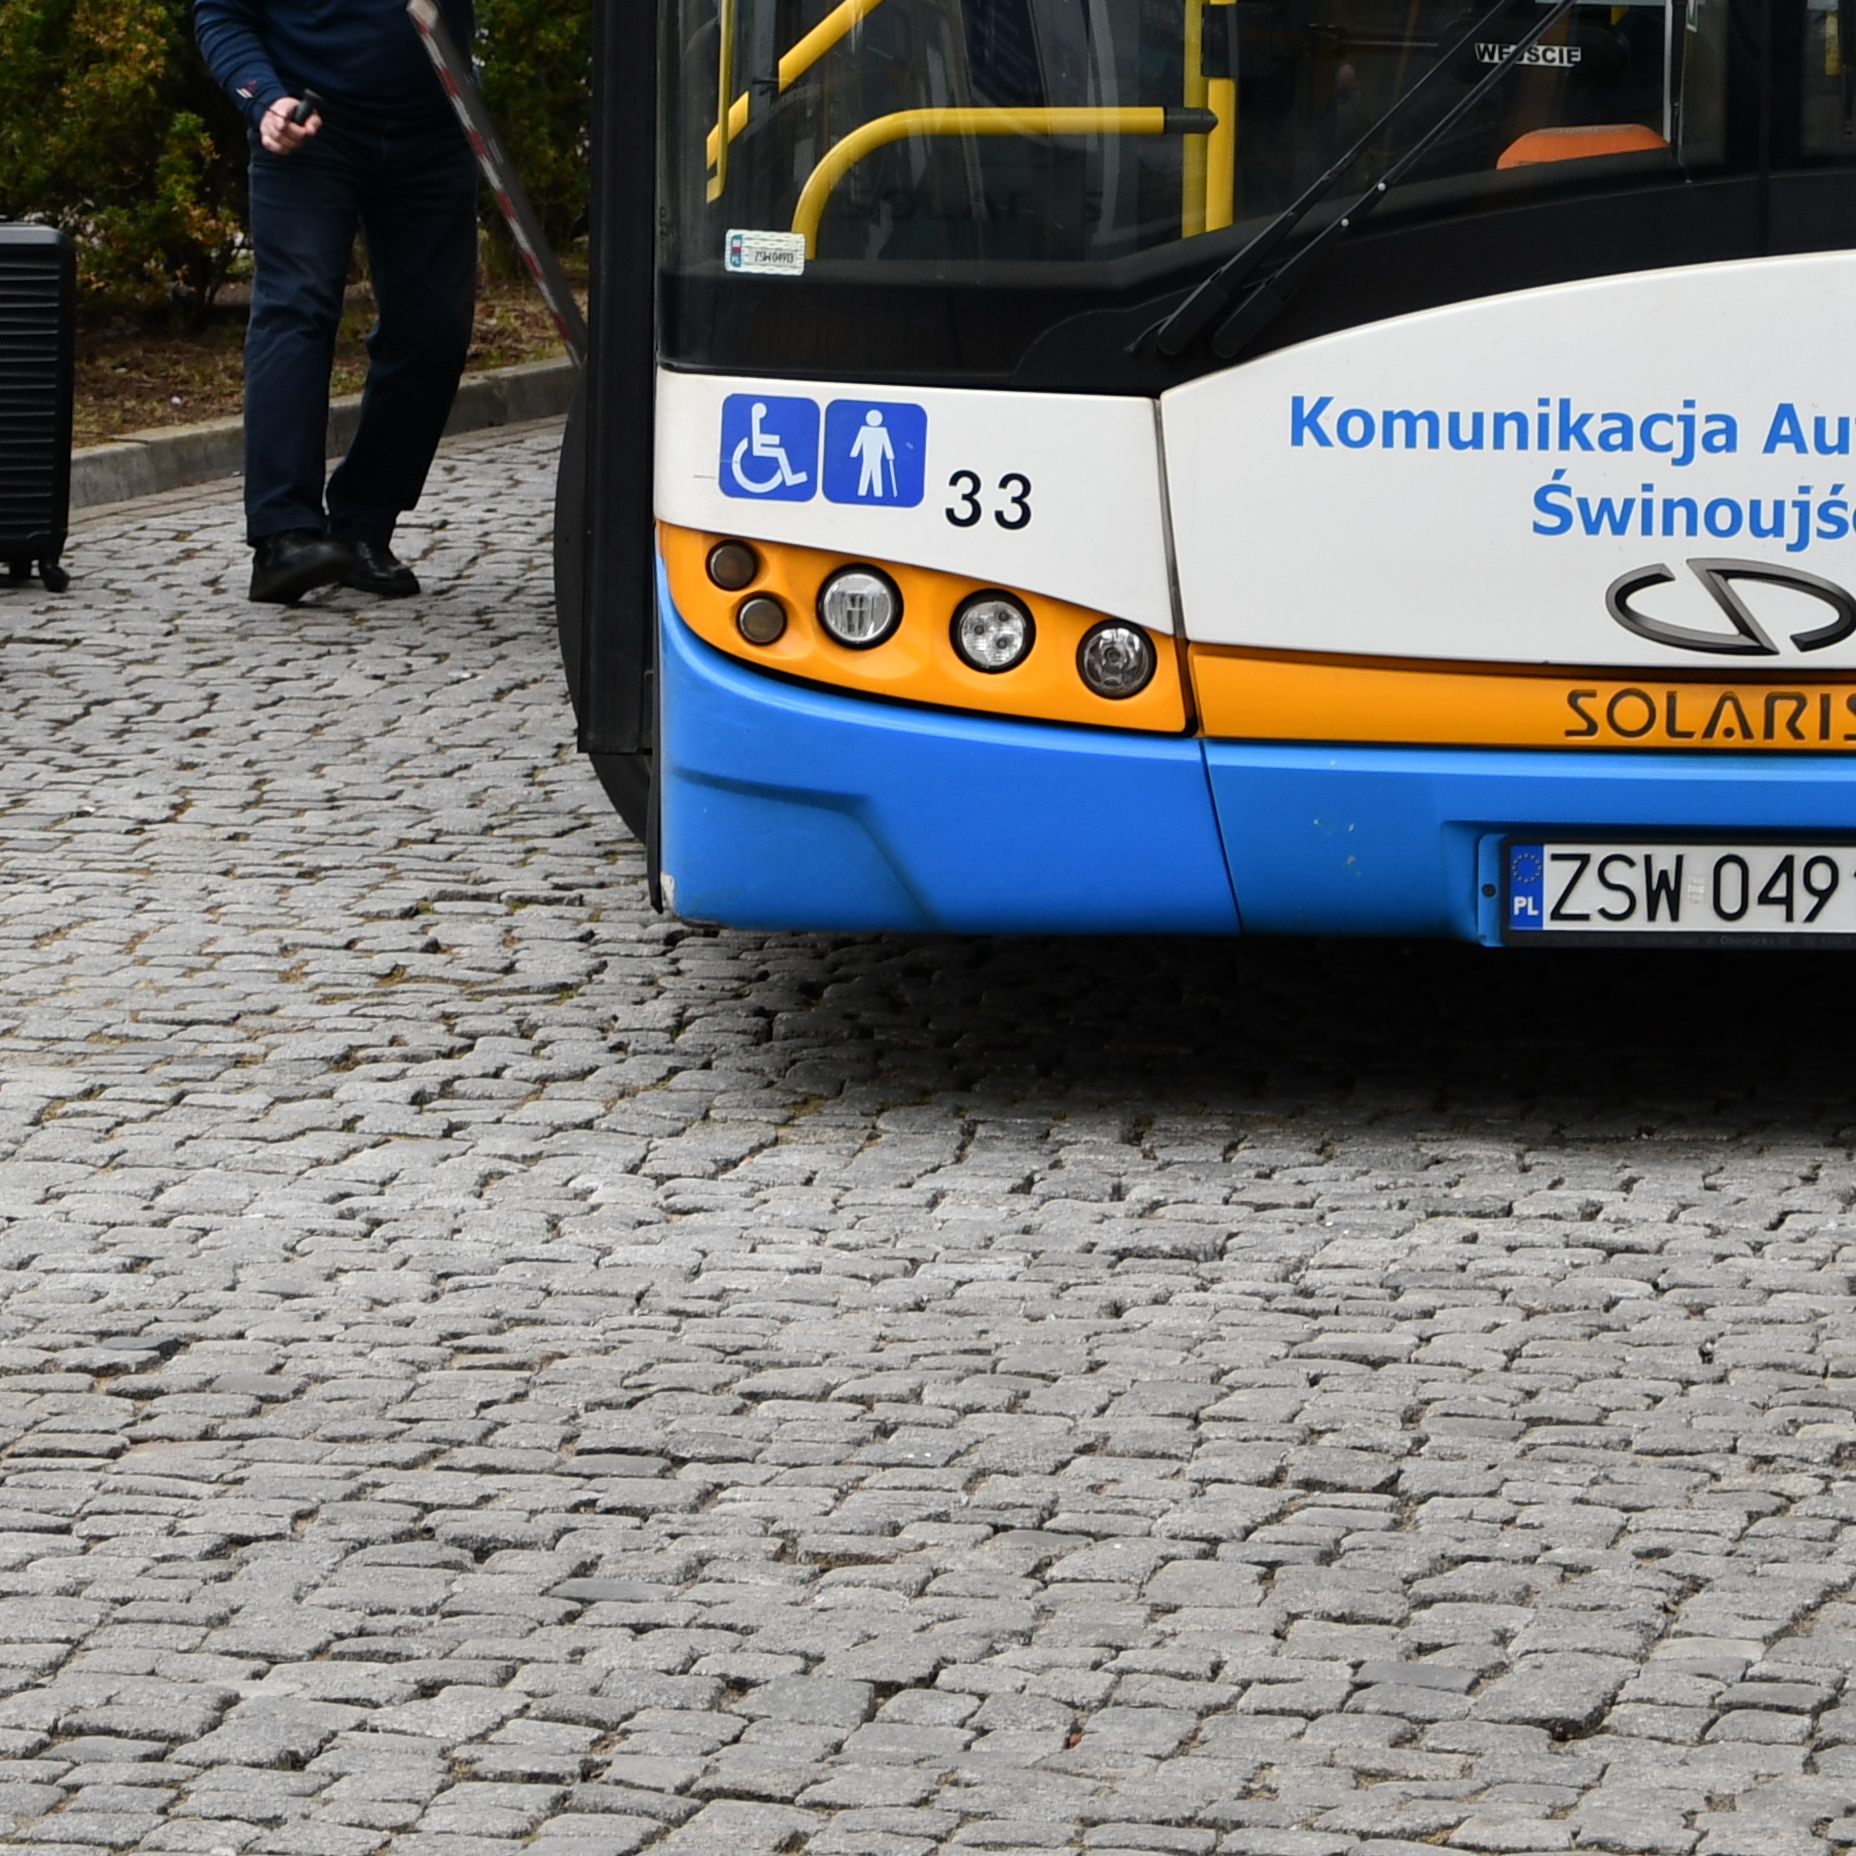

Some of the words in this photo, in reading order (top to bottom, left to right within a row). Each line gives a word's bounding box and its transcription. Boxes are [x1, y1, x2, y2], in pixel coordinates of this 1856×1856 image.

[1289, 395, 1740, 466] Komunikacja
[944, 470, 1033, 530] 33
[1512, 895, 1539, 916] PL
[1549, 852, 1684, 922] ZSW
